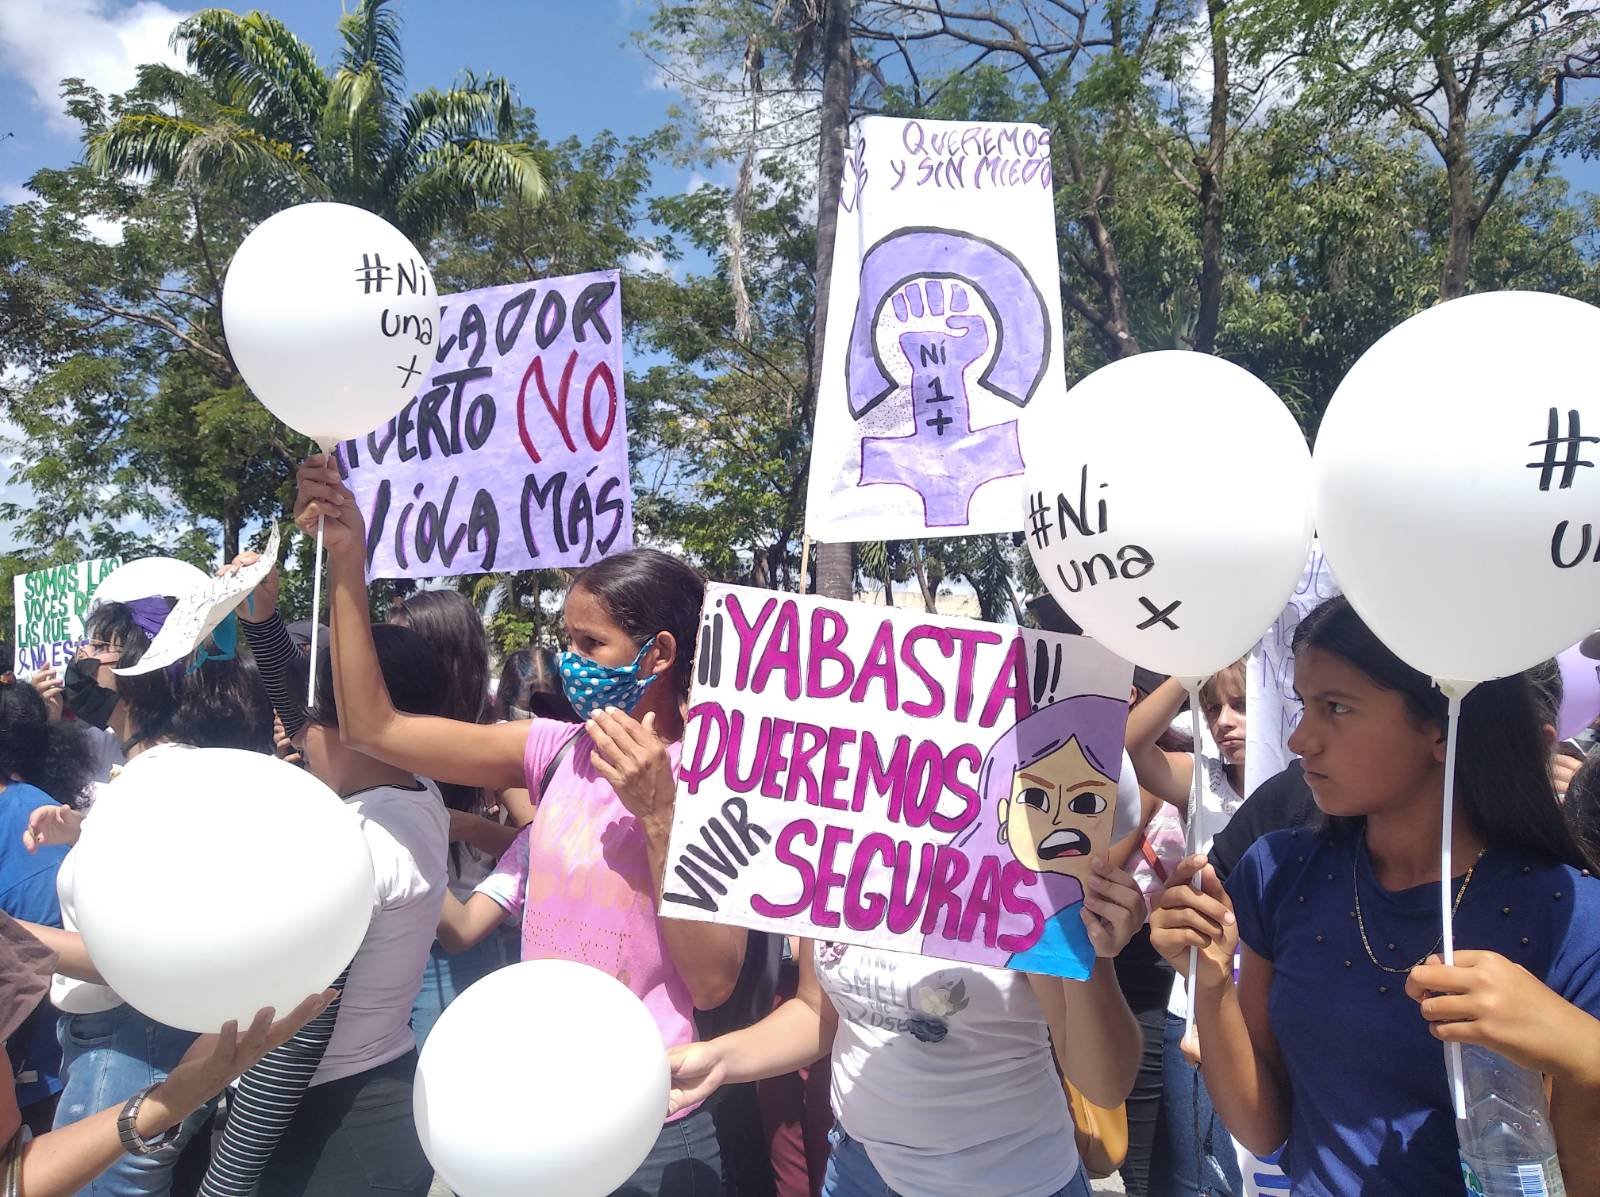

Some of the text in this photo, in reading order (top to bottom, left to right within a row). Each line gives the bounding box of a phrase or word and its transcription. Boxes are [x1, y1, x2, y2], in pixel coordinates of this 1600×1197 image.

[902, 120, 1052, 159] QUEREMOS
[917, 156, 965, 190] SIN
[974, 155, 1053, 190] MIEDO
[354, 253, 427, 296] #Ni
[381, 309, 433, 345] una
[516, 350, 617, 464] NO
[925, 376, 954, 403] 1
[1028, 464, 1109, 549] #Ni
[24, 562, 79, 600] SOMOS
[1056, 544, 1155, 593] una
[23, 590, 68, 623] VOCES
[18, 620, 41, 648] LAS
[43, 617, 71, 644] QUE
[680, 700, 981, 832] QUEREMOS
[662, 797, 771, 912] VIVIR
[750, 818, 1046, 953] SEGURAS
